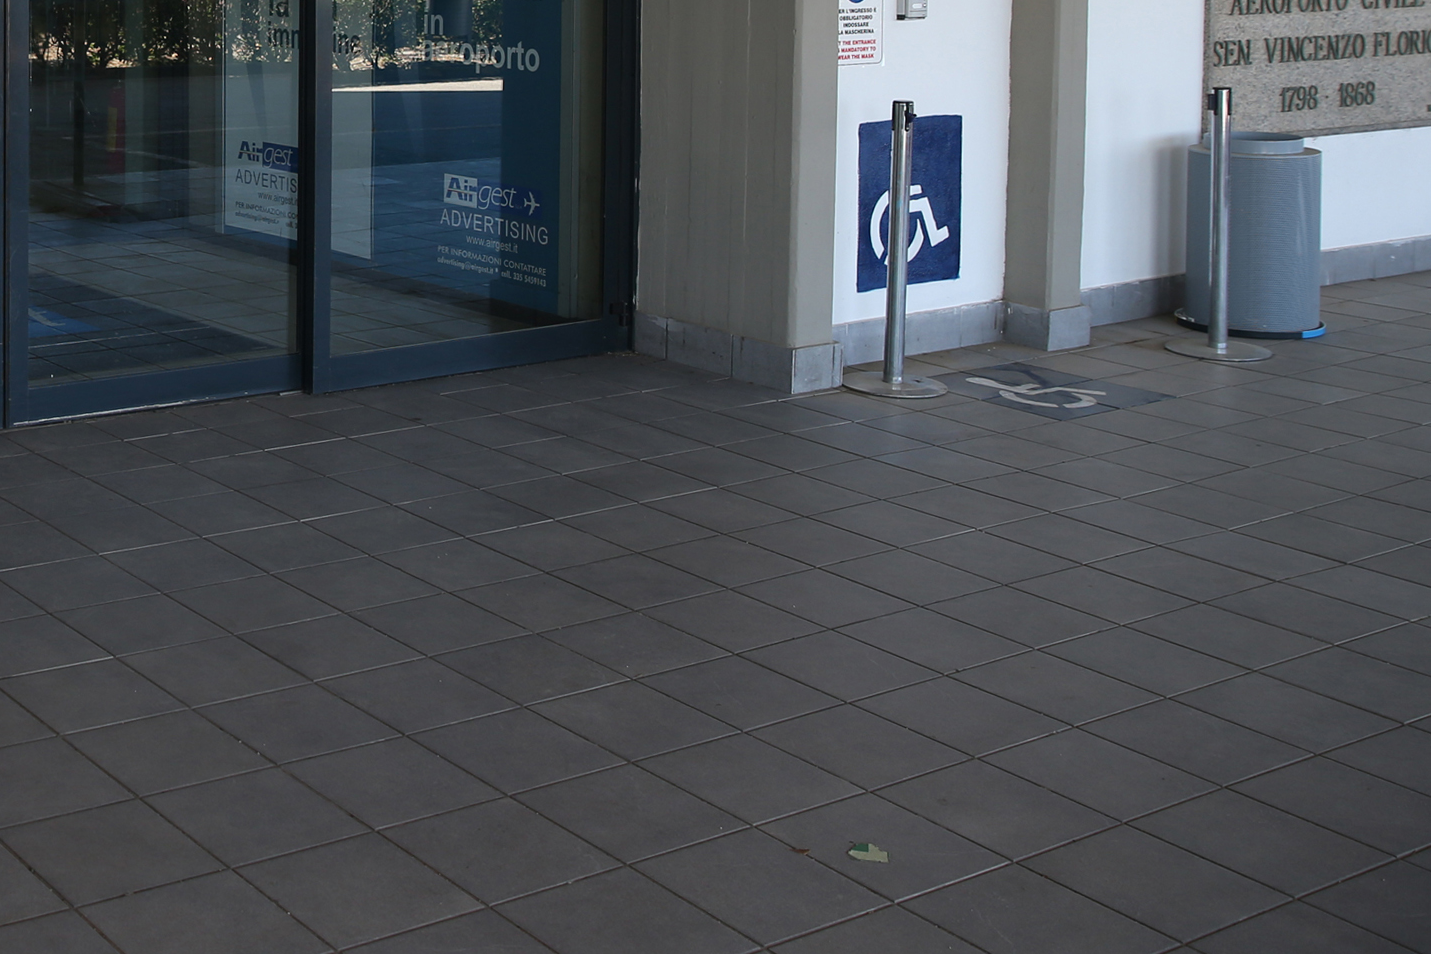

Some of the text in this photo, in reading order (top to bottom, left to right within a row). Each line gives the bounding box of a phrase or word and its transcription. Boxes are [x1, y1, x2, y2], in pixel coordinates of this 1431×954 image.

[423, 7, 445, 36] in
[422, 39, 541, 75] aeroporto
[1264, 33, 1366, 64] VINCENZO
[1279, 80, 1376, 113] 1798 1868
[237, 140, 294, 168] Airgest
[234, 168, 298, 194] ADVERTIS
[445, 176, 517, 210] Airgest
[257, 191, 298, 207] www.airgest.i
[439, 208, 550, 246] ADVERTISING
[466, 235, 519, 254] www.airgest.it
[437, 245, 548, 277] PER INFORMAZIONI CONTATTARE
